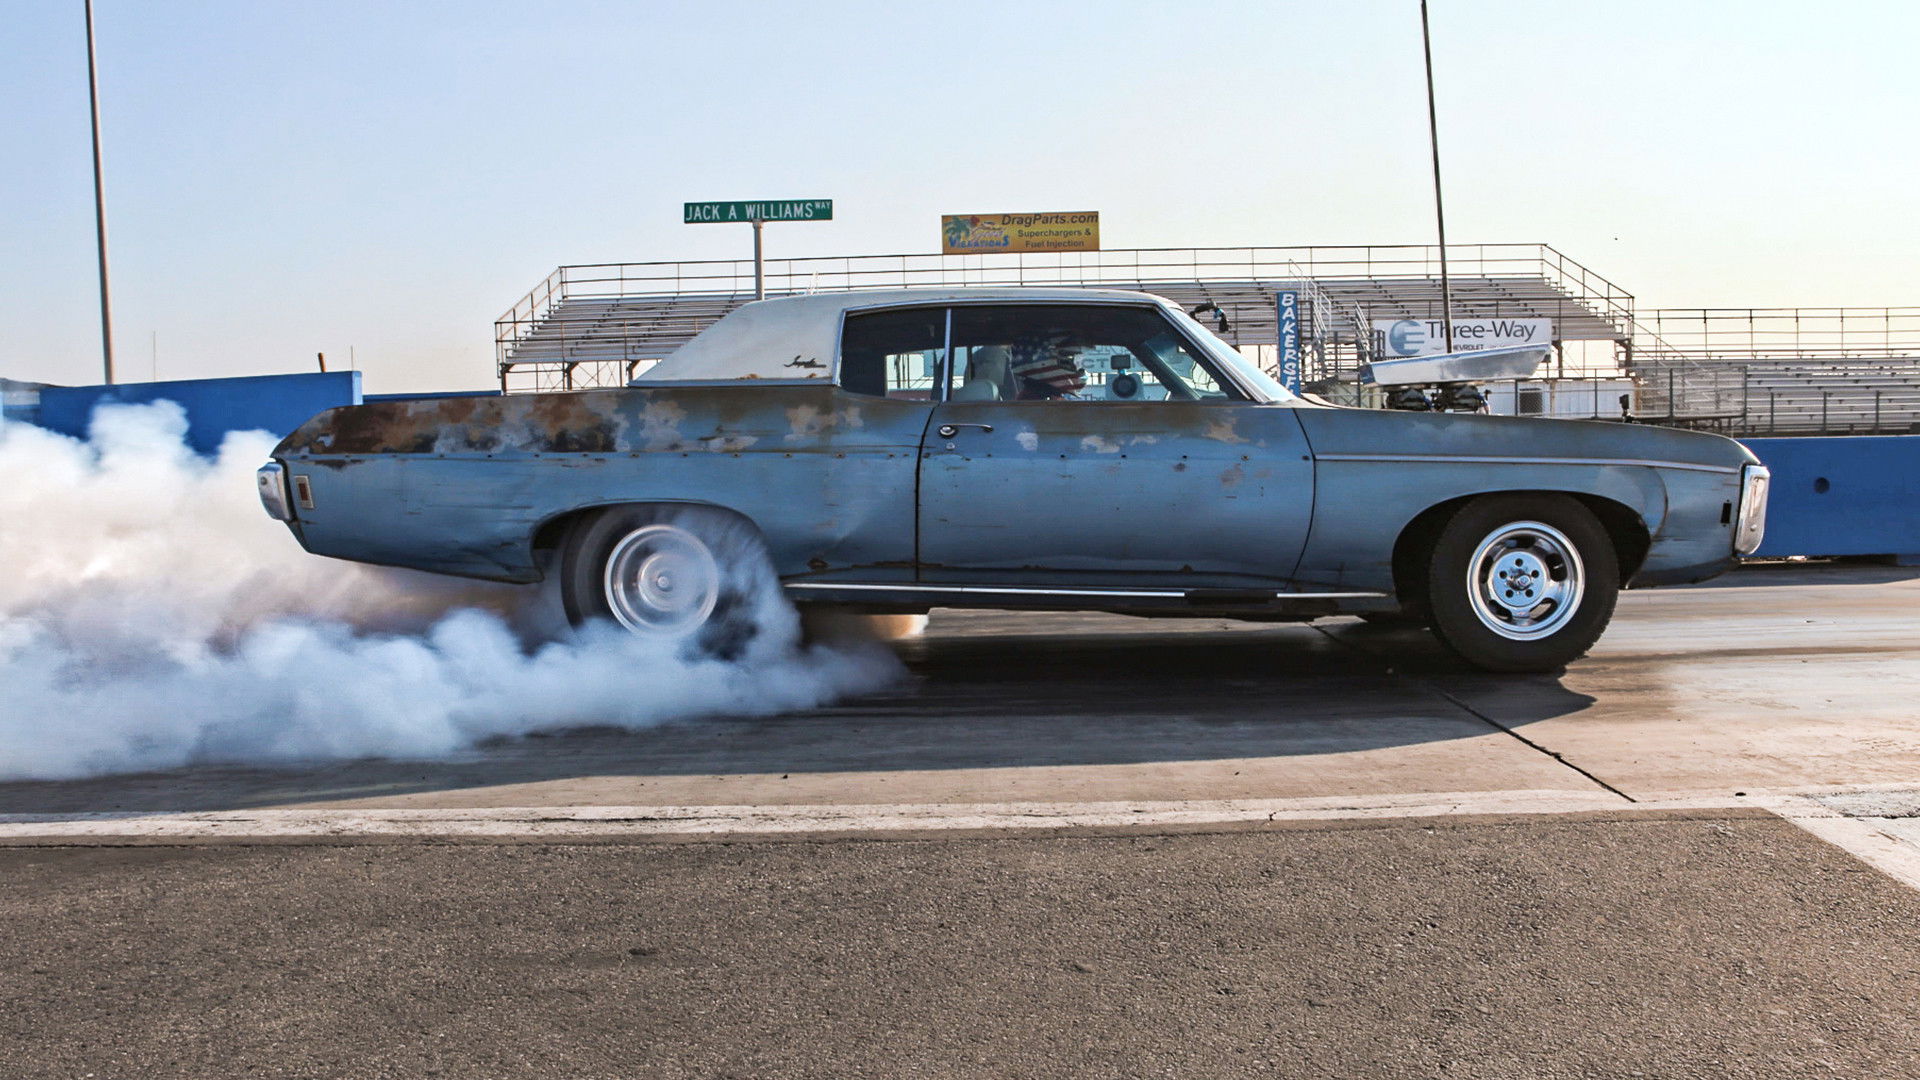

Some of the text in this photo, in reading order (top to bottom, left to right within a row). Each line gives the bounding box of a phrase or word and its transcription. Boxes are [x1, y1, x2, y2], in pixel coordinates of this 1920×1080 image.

[685, 201, 831, 221] JACK A WILLIAMS WAY
[1001, 213, 1099, 228] DragParts.com
[1017, 228, 1092, 239] Superchargers &
[1025, 239, 1085, 249] Fuel Injection
[1425, 320, 1537, 342] Three-Way
[1281, 293, 1297, 393] BAKERSF
